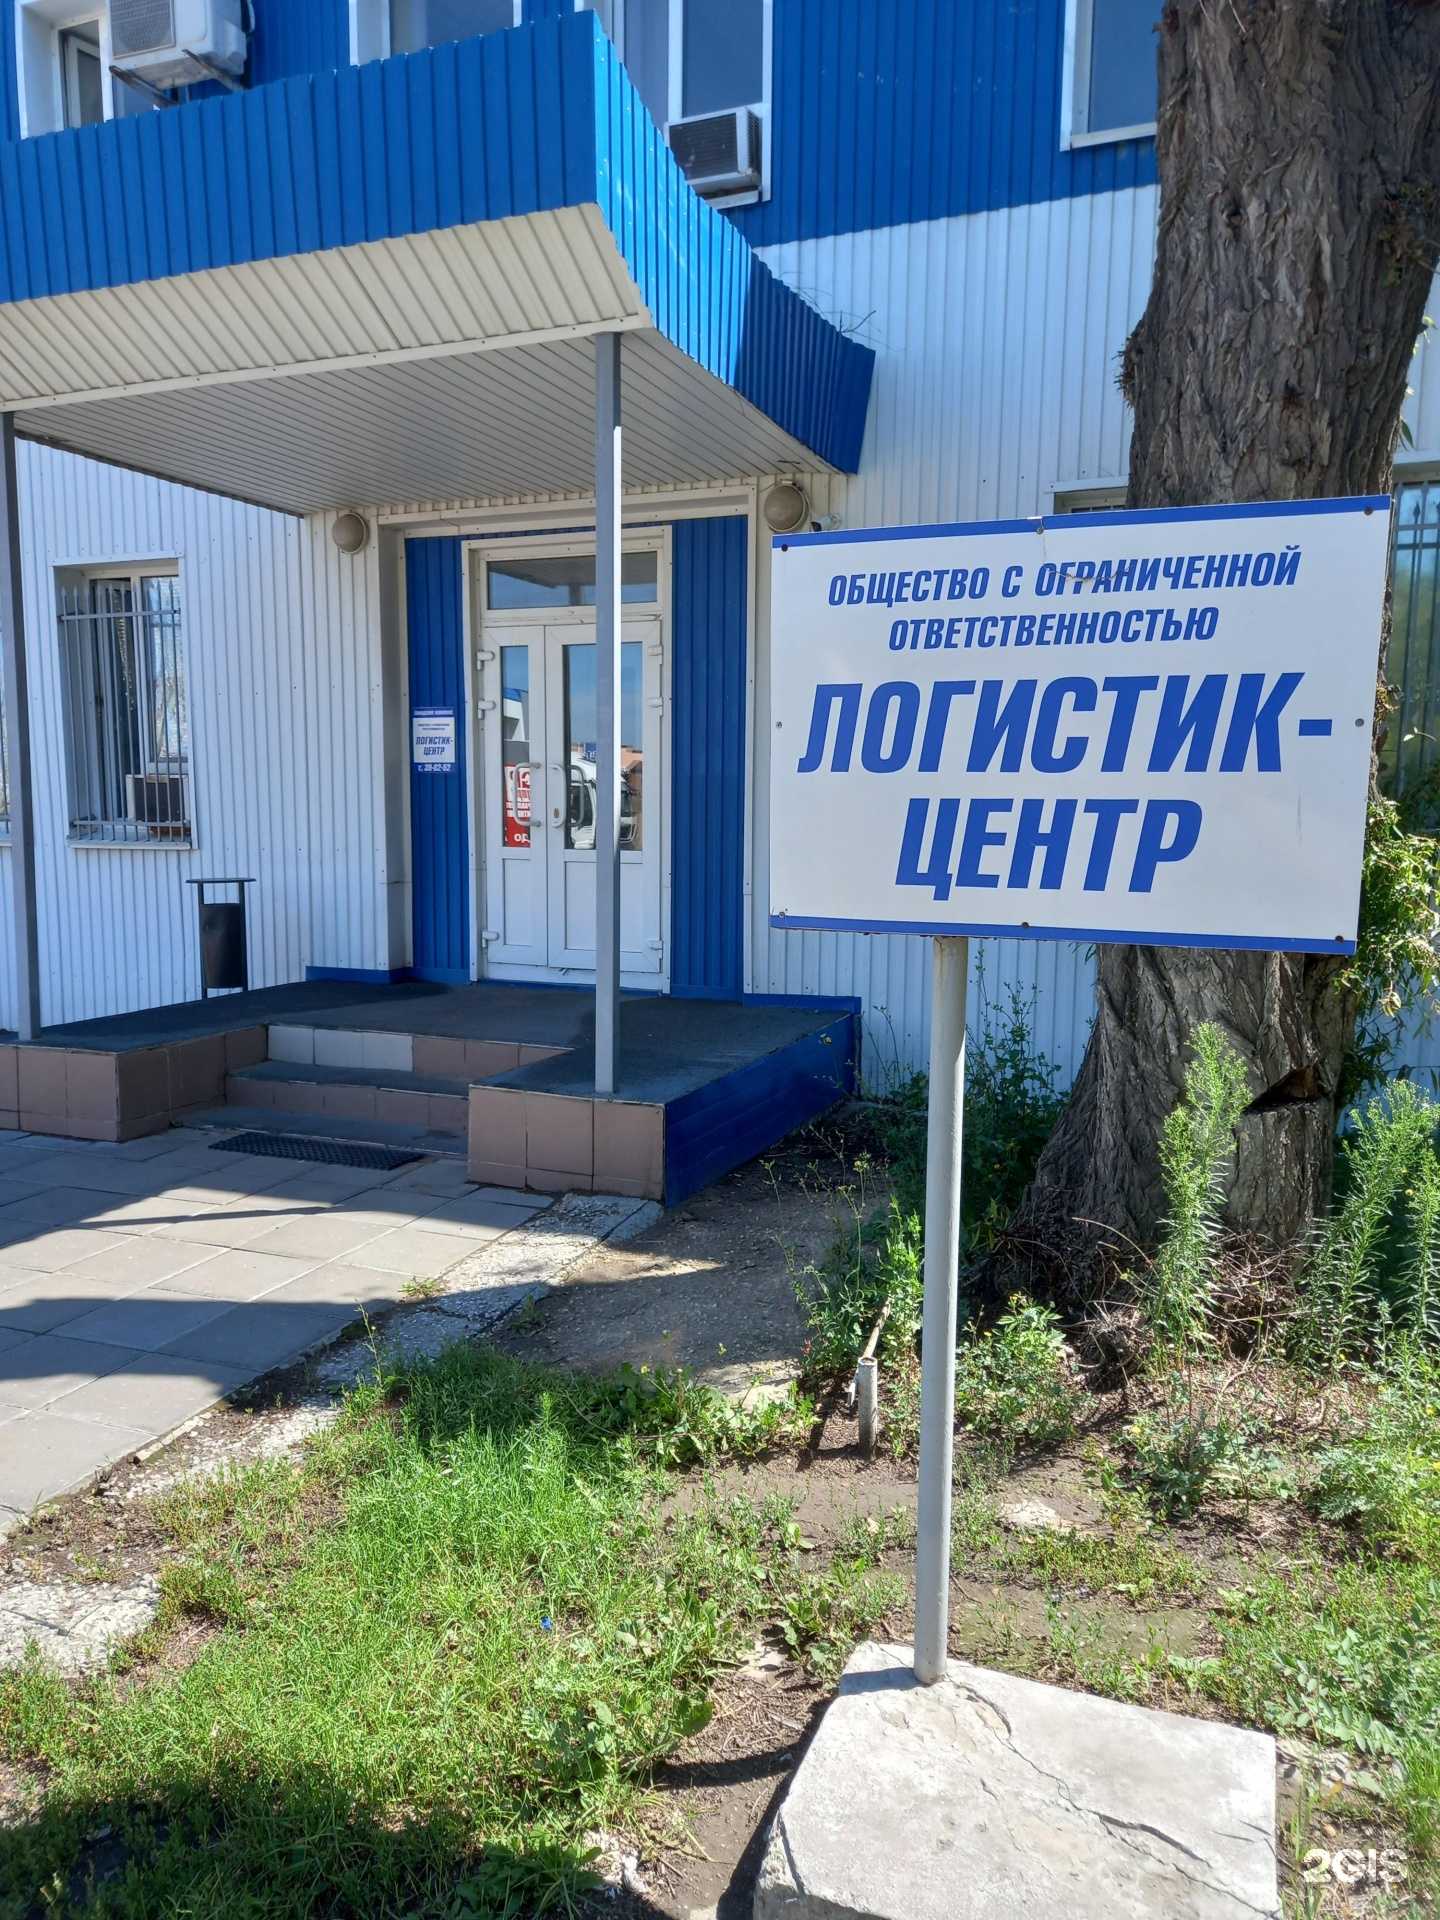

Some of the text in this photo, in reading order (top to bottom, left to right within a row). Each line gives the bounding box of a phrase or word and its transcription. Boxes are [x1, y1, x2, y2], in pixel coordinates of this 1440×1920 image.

[827, 545, 1302, 608] ОБЩЕСТВО С ОГРАНИЧЕННОЙ
[888, 607, 1220, 652] ОТВЕТСТВЕННОСТЬЮ
[423, 746, 446, 756] ЦЕНТР
[797, 671, 1333, 775] ЛОГИСТИК-
[895, 797, 1203, 901] ЦЕНТР
